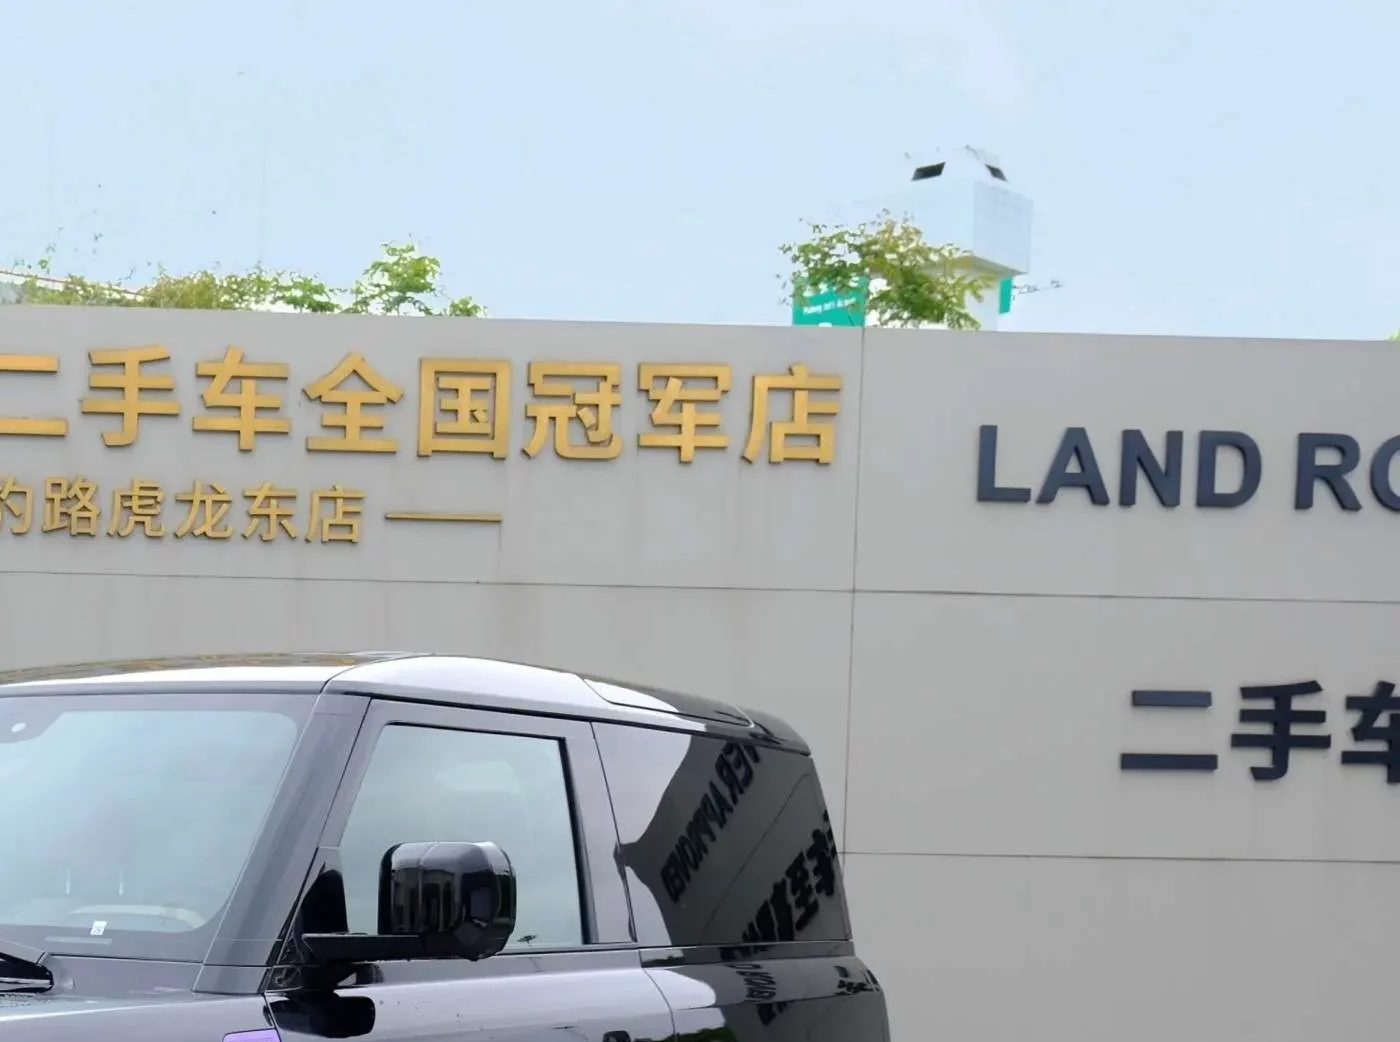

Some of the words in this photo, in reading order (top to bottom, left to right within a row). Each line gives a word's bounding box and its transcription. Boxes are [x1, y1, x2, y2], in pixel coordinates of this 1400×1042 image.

[976, 424, 1263, 509] LAND
[1120, 679, 1400, 786] 二手车
